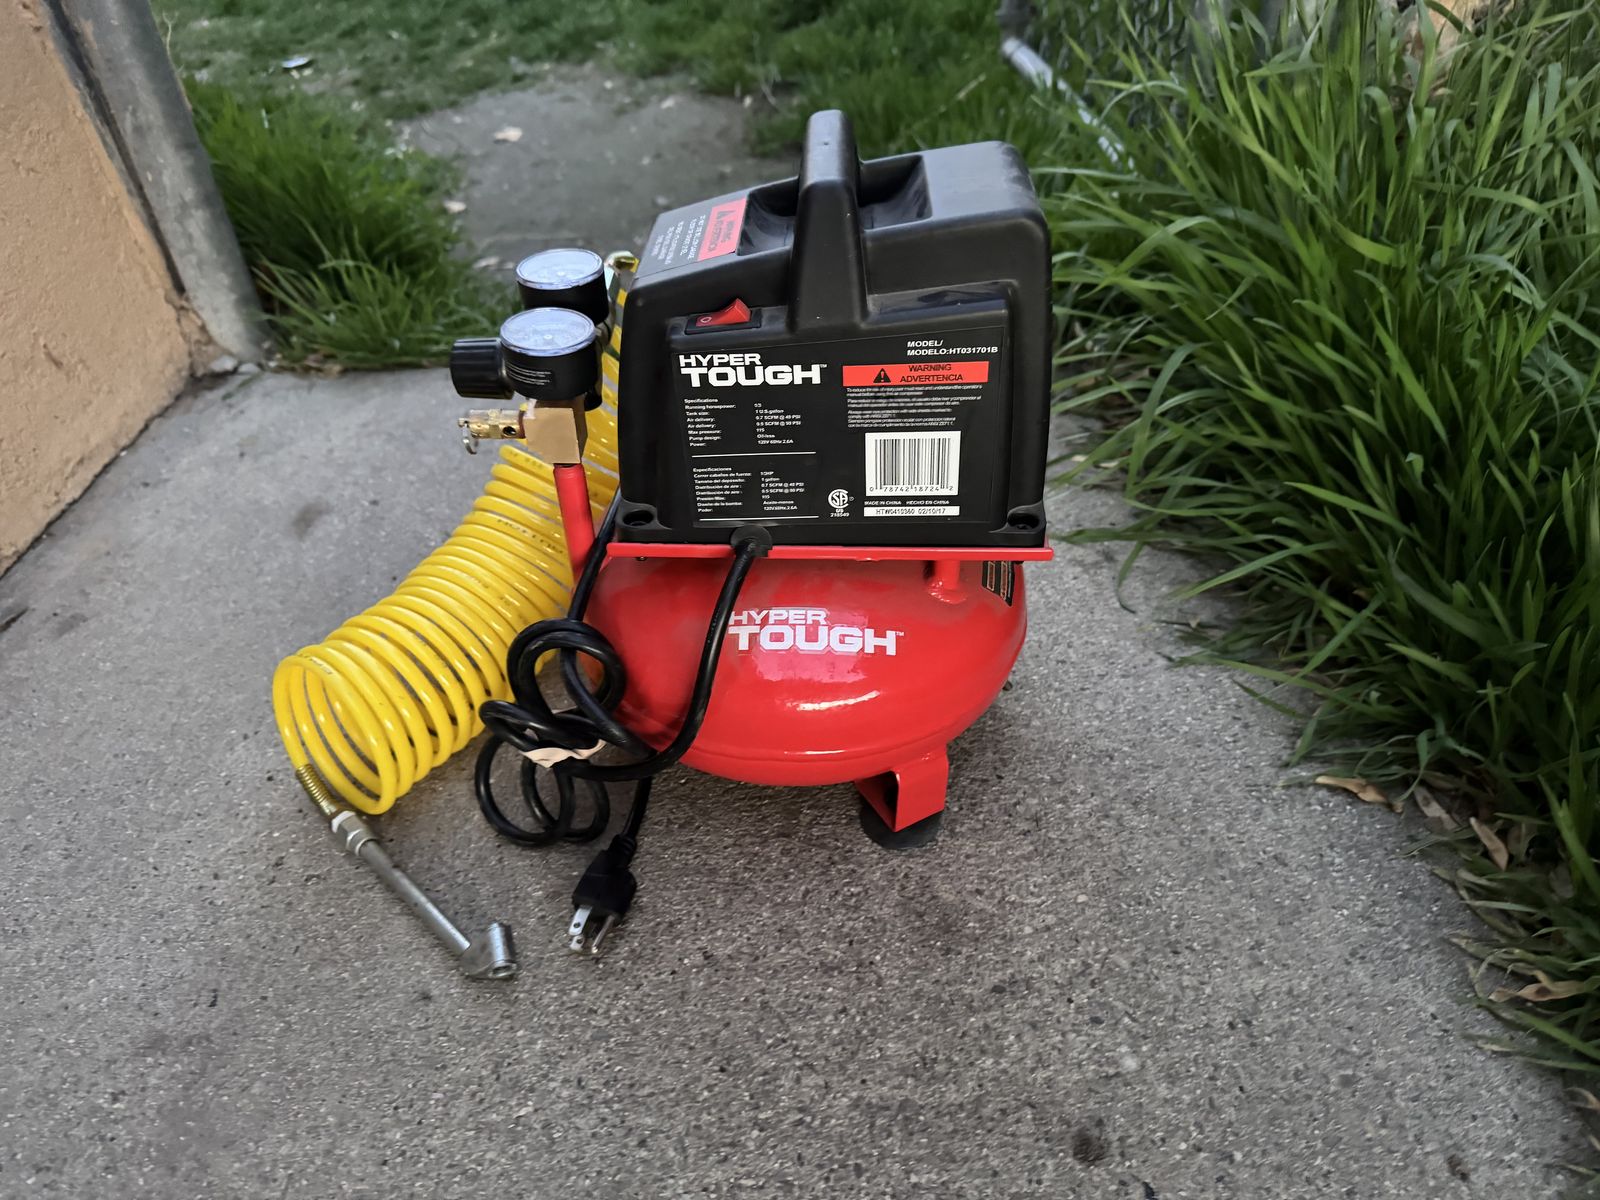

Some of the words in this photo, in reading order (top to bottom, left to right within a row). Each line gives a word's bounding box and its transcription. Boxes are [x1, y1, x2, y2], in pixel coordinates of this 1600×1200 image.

[907, 340, 944, 348] MODEL/
[679, 353, 762, 367] HYPER
[908, 363, 952, 372] WARNING
[680, 363, 821, 388] TOUGH
[899, 374, 963, 383] ADVERTENCIA
[728, 609, 828, 625] HYPER
[728, 624, 897, 656] TOUGH
